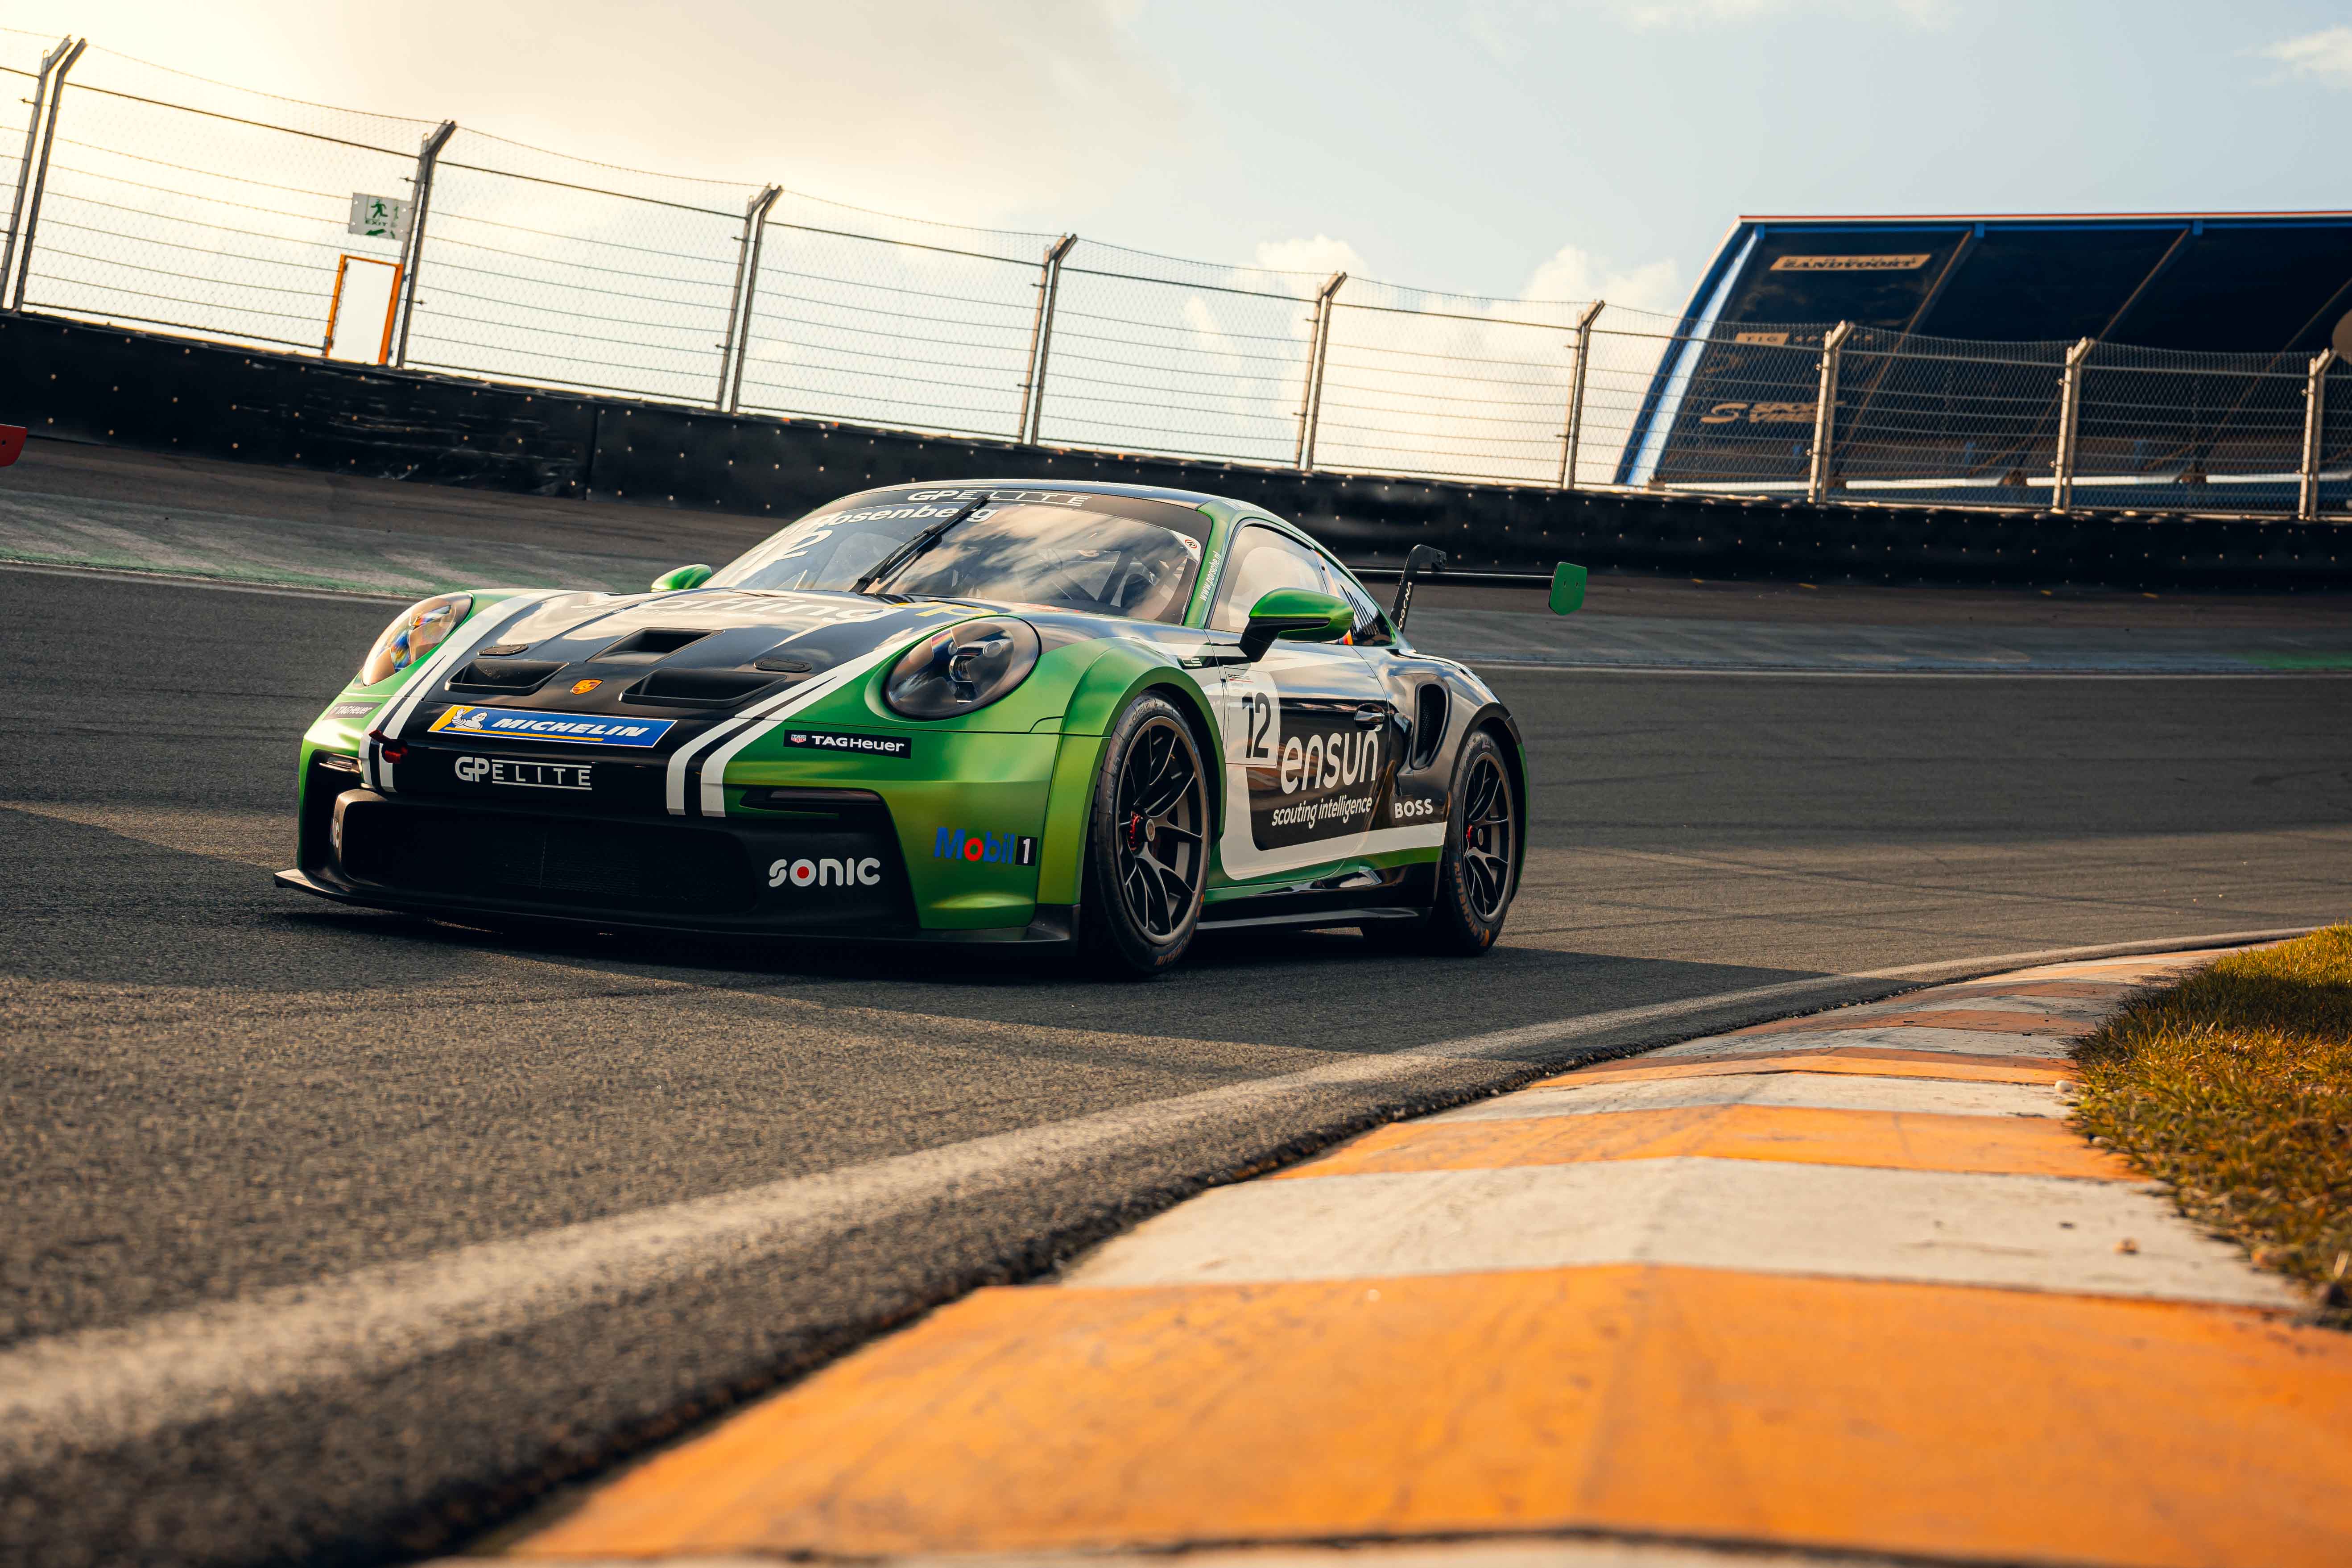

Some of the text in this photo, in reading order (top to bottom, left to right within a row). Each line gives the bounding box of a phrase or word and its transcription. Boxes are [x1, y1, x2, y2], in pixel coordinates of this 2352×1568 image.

[814, 505, 1000, 531] Rosenbeg
[1199, 550, 1222, 602] www.porsche.nl
[491, 718, 650, 736] MICHELIN
[1241, 692, 1272, 759] 12
[1281, 730, 1379, 794] ensun
[1271, 794, 1373, 829] scouting intelligence
[1394, 798, 1434, 819] BOSS
[934, 827, 1016, 864] Mobil
